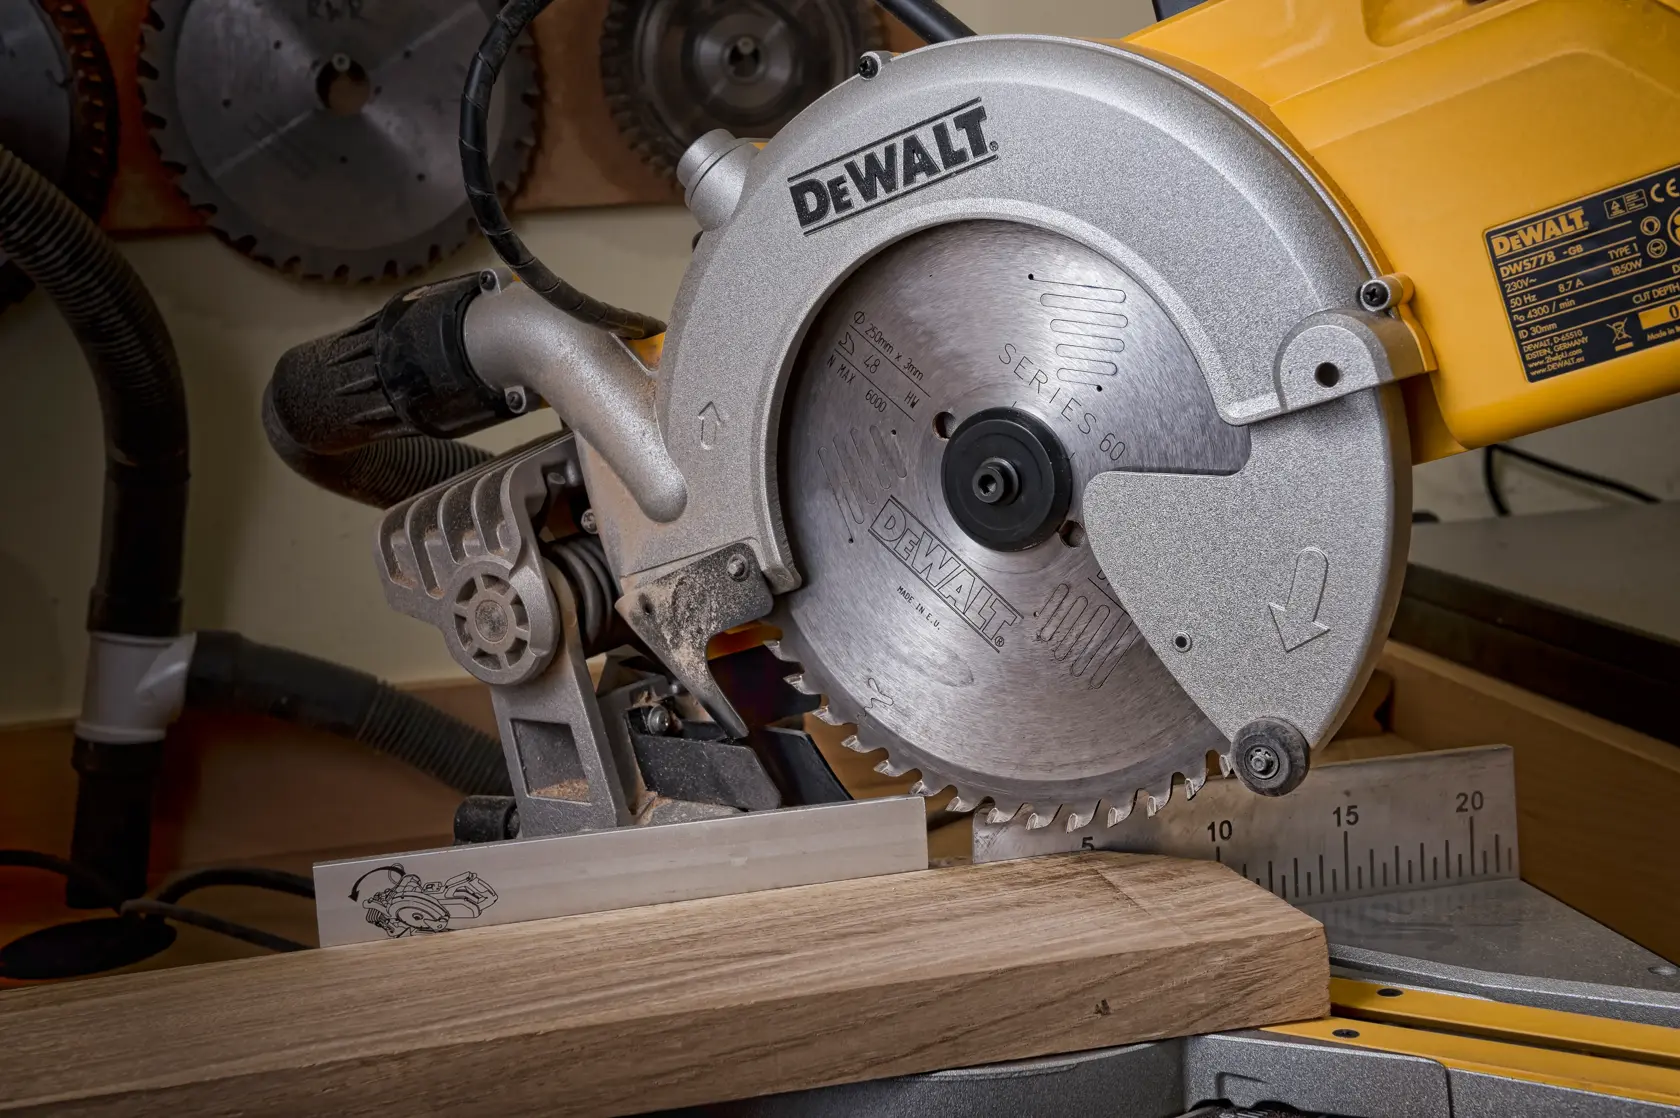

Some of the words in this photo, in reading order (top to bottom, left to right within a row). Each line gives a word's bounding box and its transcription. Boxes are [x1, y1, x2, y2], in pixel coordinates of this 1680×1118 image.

[1608, 245, 1631, 260] TYPE
[1633, 242, 1638, 252] 1
[1500, 251, 1556, 278] DWS778
[1510, 297, 1522, 308] 50
[1523, 294, 1537, 304] Hz
[1558, 281, 1572, 292] 8.7
[1576, 278, 1584, 288] A
[1611, 258, 1642, 276] 1850W
[1519, 329, 1528, 339] ID
[1530, 323, 1557, 336] 30mm
[1632, 290, 1651, 304] CUT
[1652, 282, 1680, 298] DEPTH
[1527, 305, 1549, 319] 4300
[1559, 299, 1575, 310] min
[1553, 329, 1583, 343] D-65510
[1553, 336, 1589, 352] GERMANY
[865, 323, 894, 354] 250mm
[895, 353, 903, 362] x
[903, 357, 924, 381] 3mm
[827, 354, 837, 368] N
[837, 364, 856, 386] MAX
[865, 389, 887, 413] 6000
[863, 355, 881, 374] 48
[904, 390, 920, 409] HW
[999, 343, 1097, 435] SERIES
[1100, 433, 1126, 461] 60
[897, 585, 914, 604] MADE
[915, 603, 926, 614] IN
[926, 612, 940, 631] E.U.
[1456, 790, 1484, 813] 20
[1332, 805, 1359, 827] 15
[1082, 836, 1094, 851] 5
[1207, 820, 1233, 842] 10
